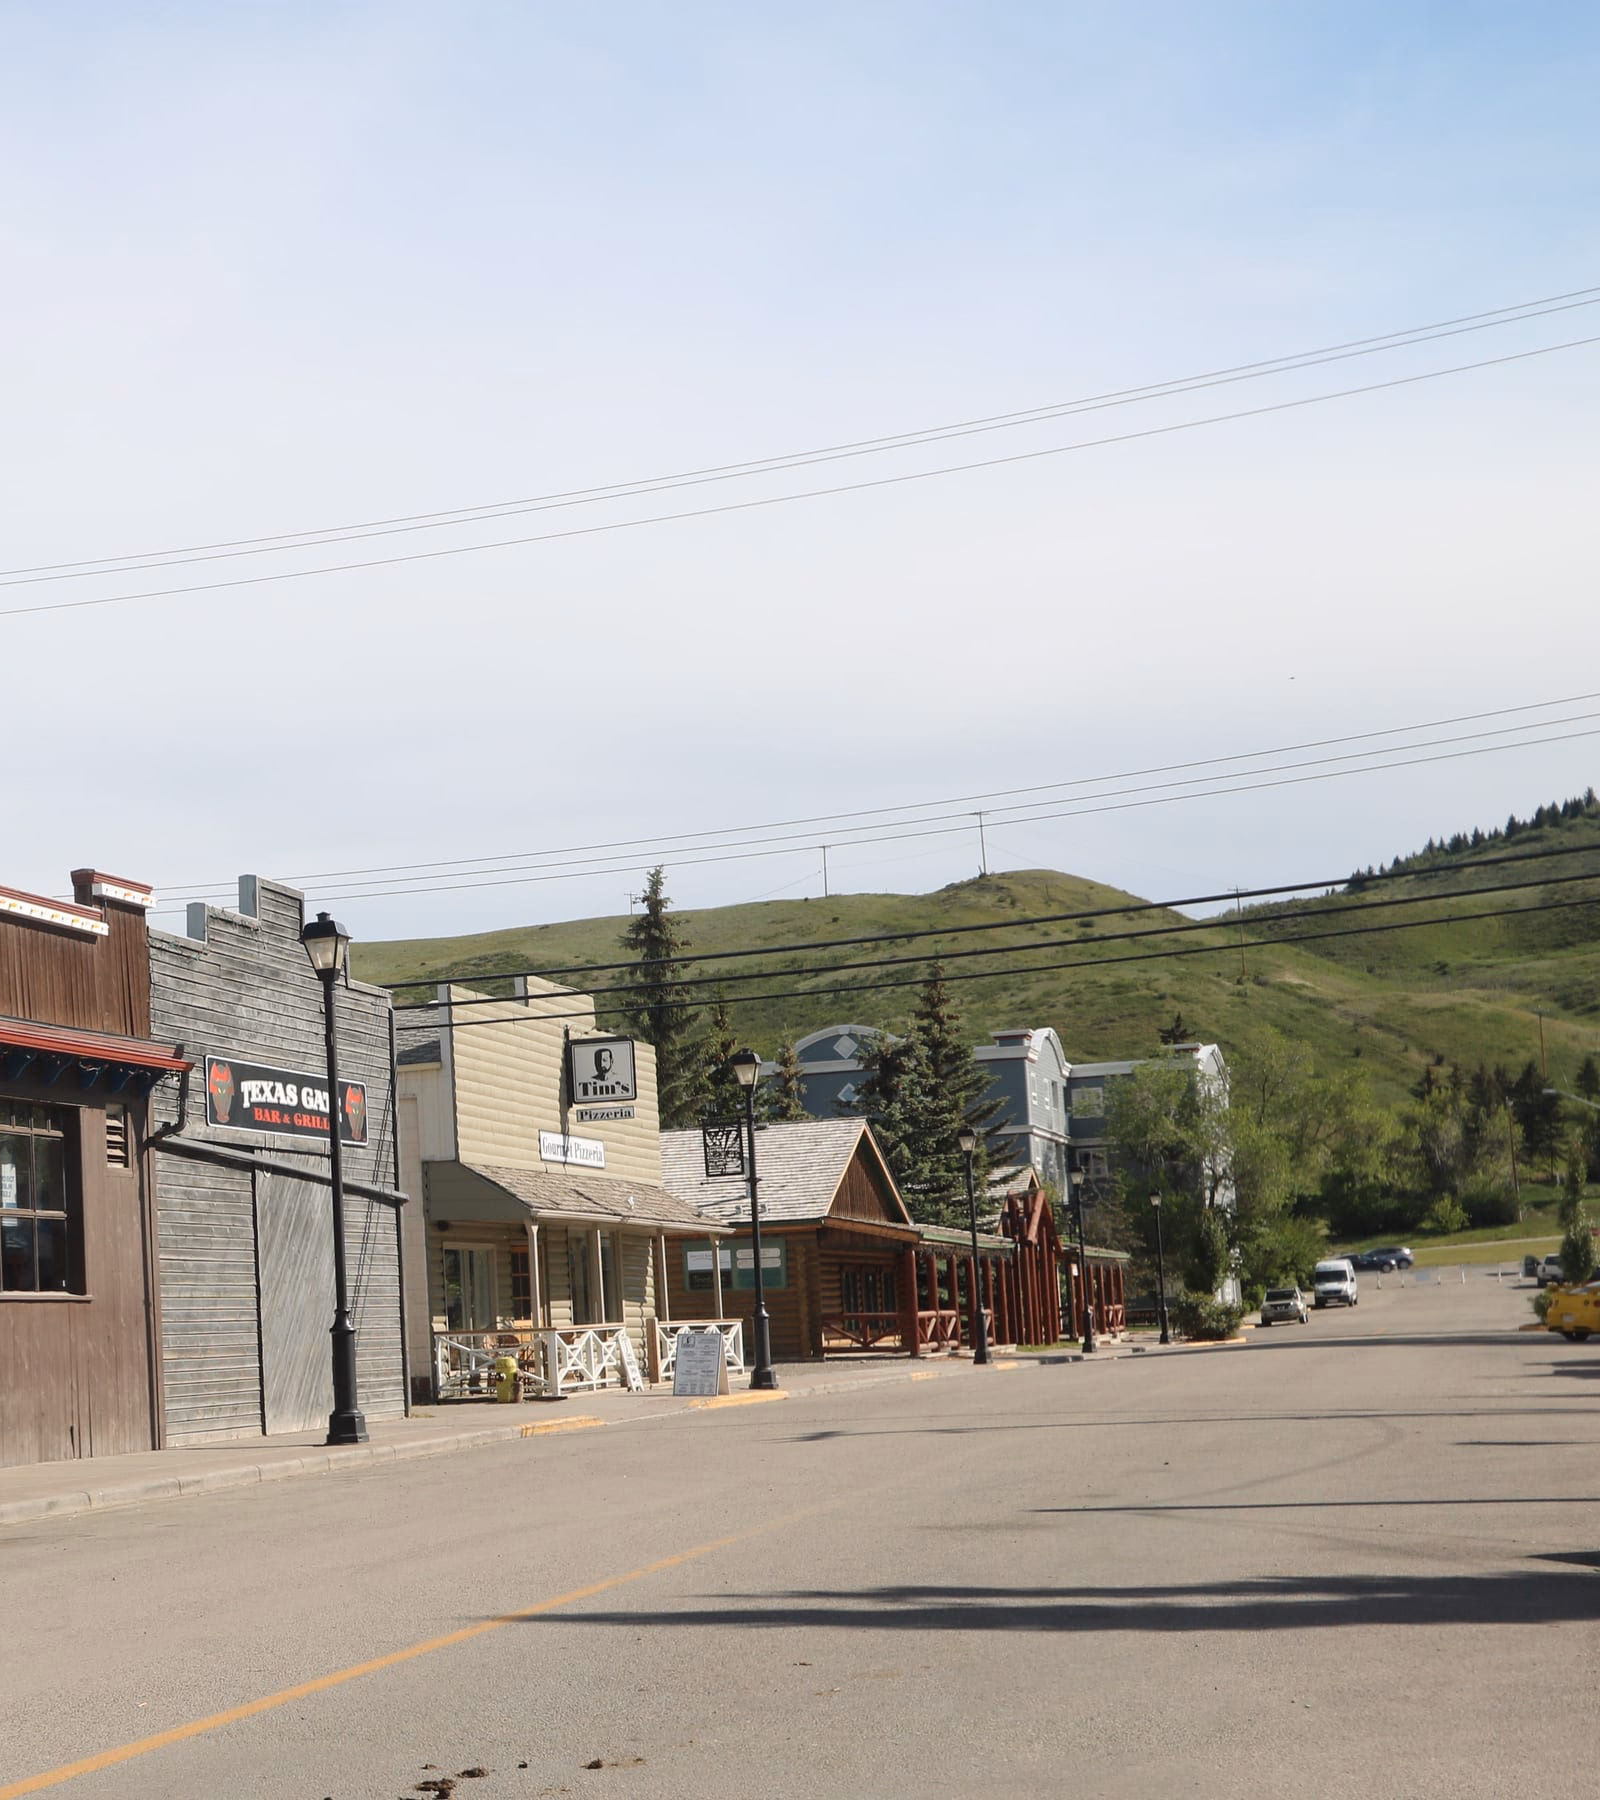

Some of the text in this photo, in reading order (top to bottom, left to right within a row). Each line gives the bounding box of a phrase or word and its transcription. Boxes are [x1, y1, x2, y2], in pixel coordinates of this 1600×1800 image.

[241, 1080, 298, 1108] TEXAS
[578, 1081, 630, 1096] Tim's
[254, 1107, 281, 1123] BAR
[283, 1115, 290, 1123] &
[579, 1108, 631, 1121] Pizzeria
[574, 1142, 603, 1161] Pizzeria
